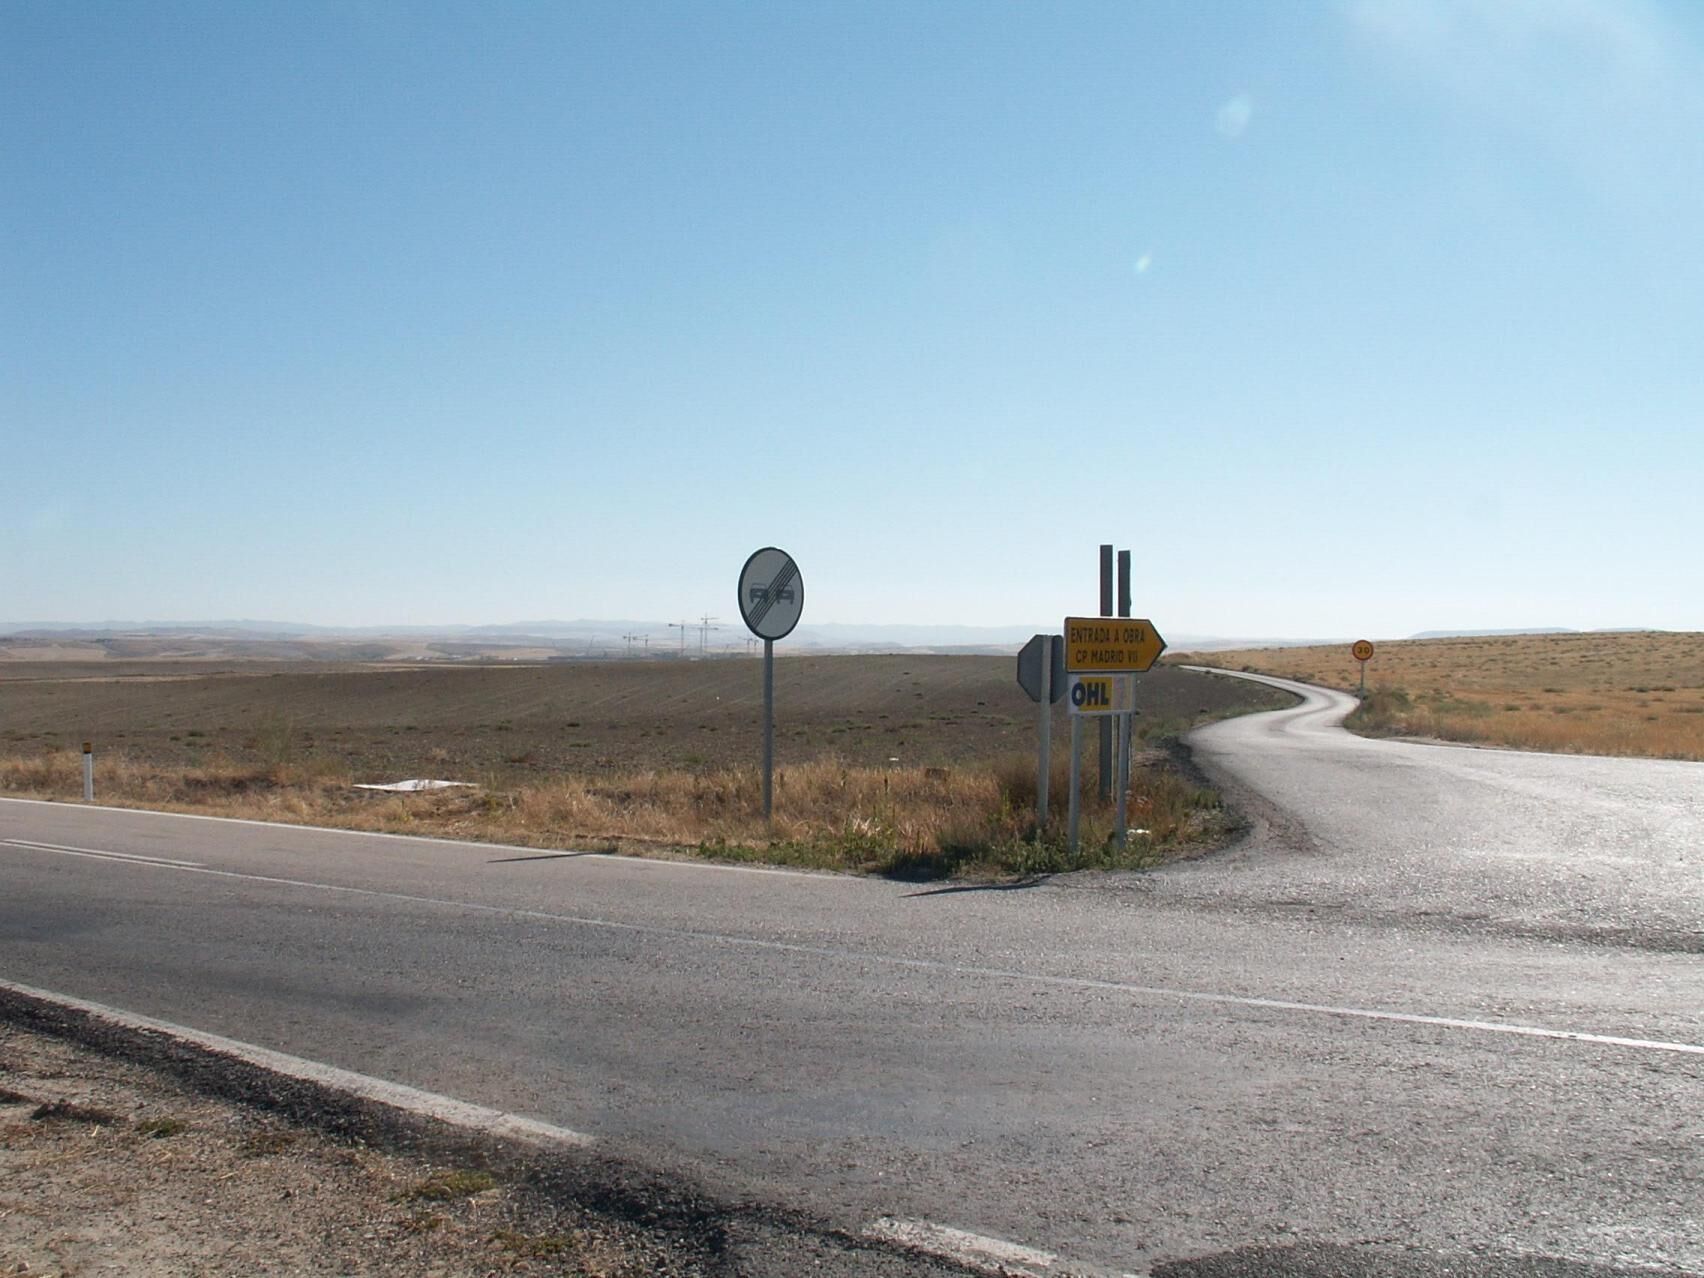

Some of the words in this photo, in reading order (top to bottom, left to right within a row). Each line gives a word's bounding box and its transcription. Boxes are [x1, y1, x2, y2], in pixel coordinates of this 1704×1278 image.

[1071, 627, 1110, 643] ENTRADA
[1114, 628, 1120, 642] A
[1123, 628, 1145, 642] OBRA
[1076, 650, 1087, 663] CP
[1091, 650, 1124, 663] MADRID
[1071, 682, 1109, 706] OHL
